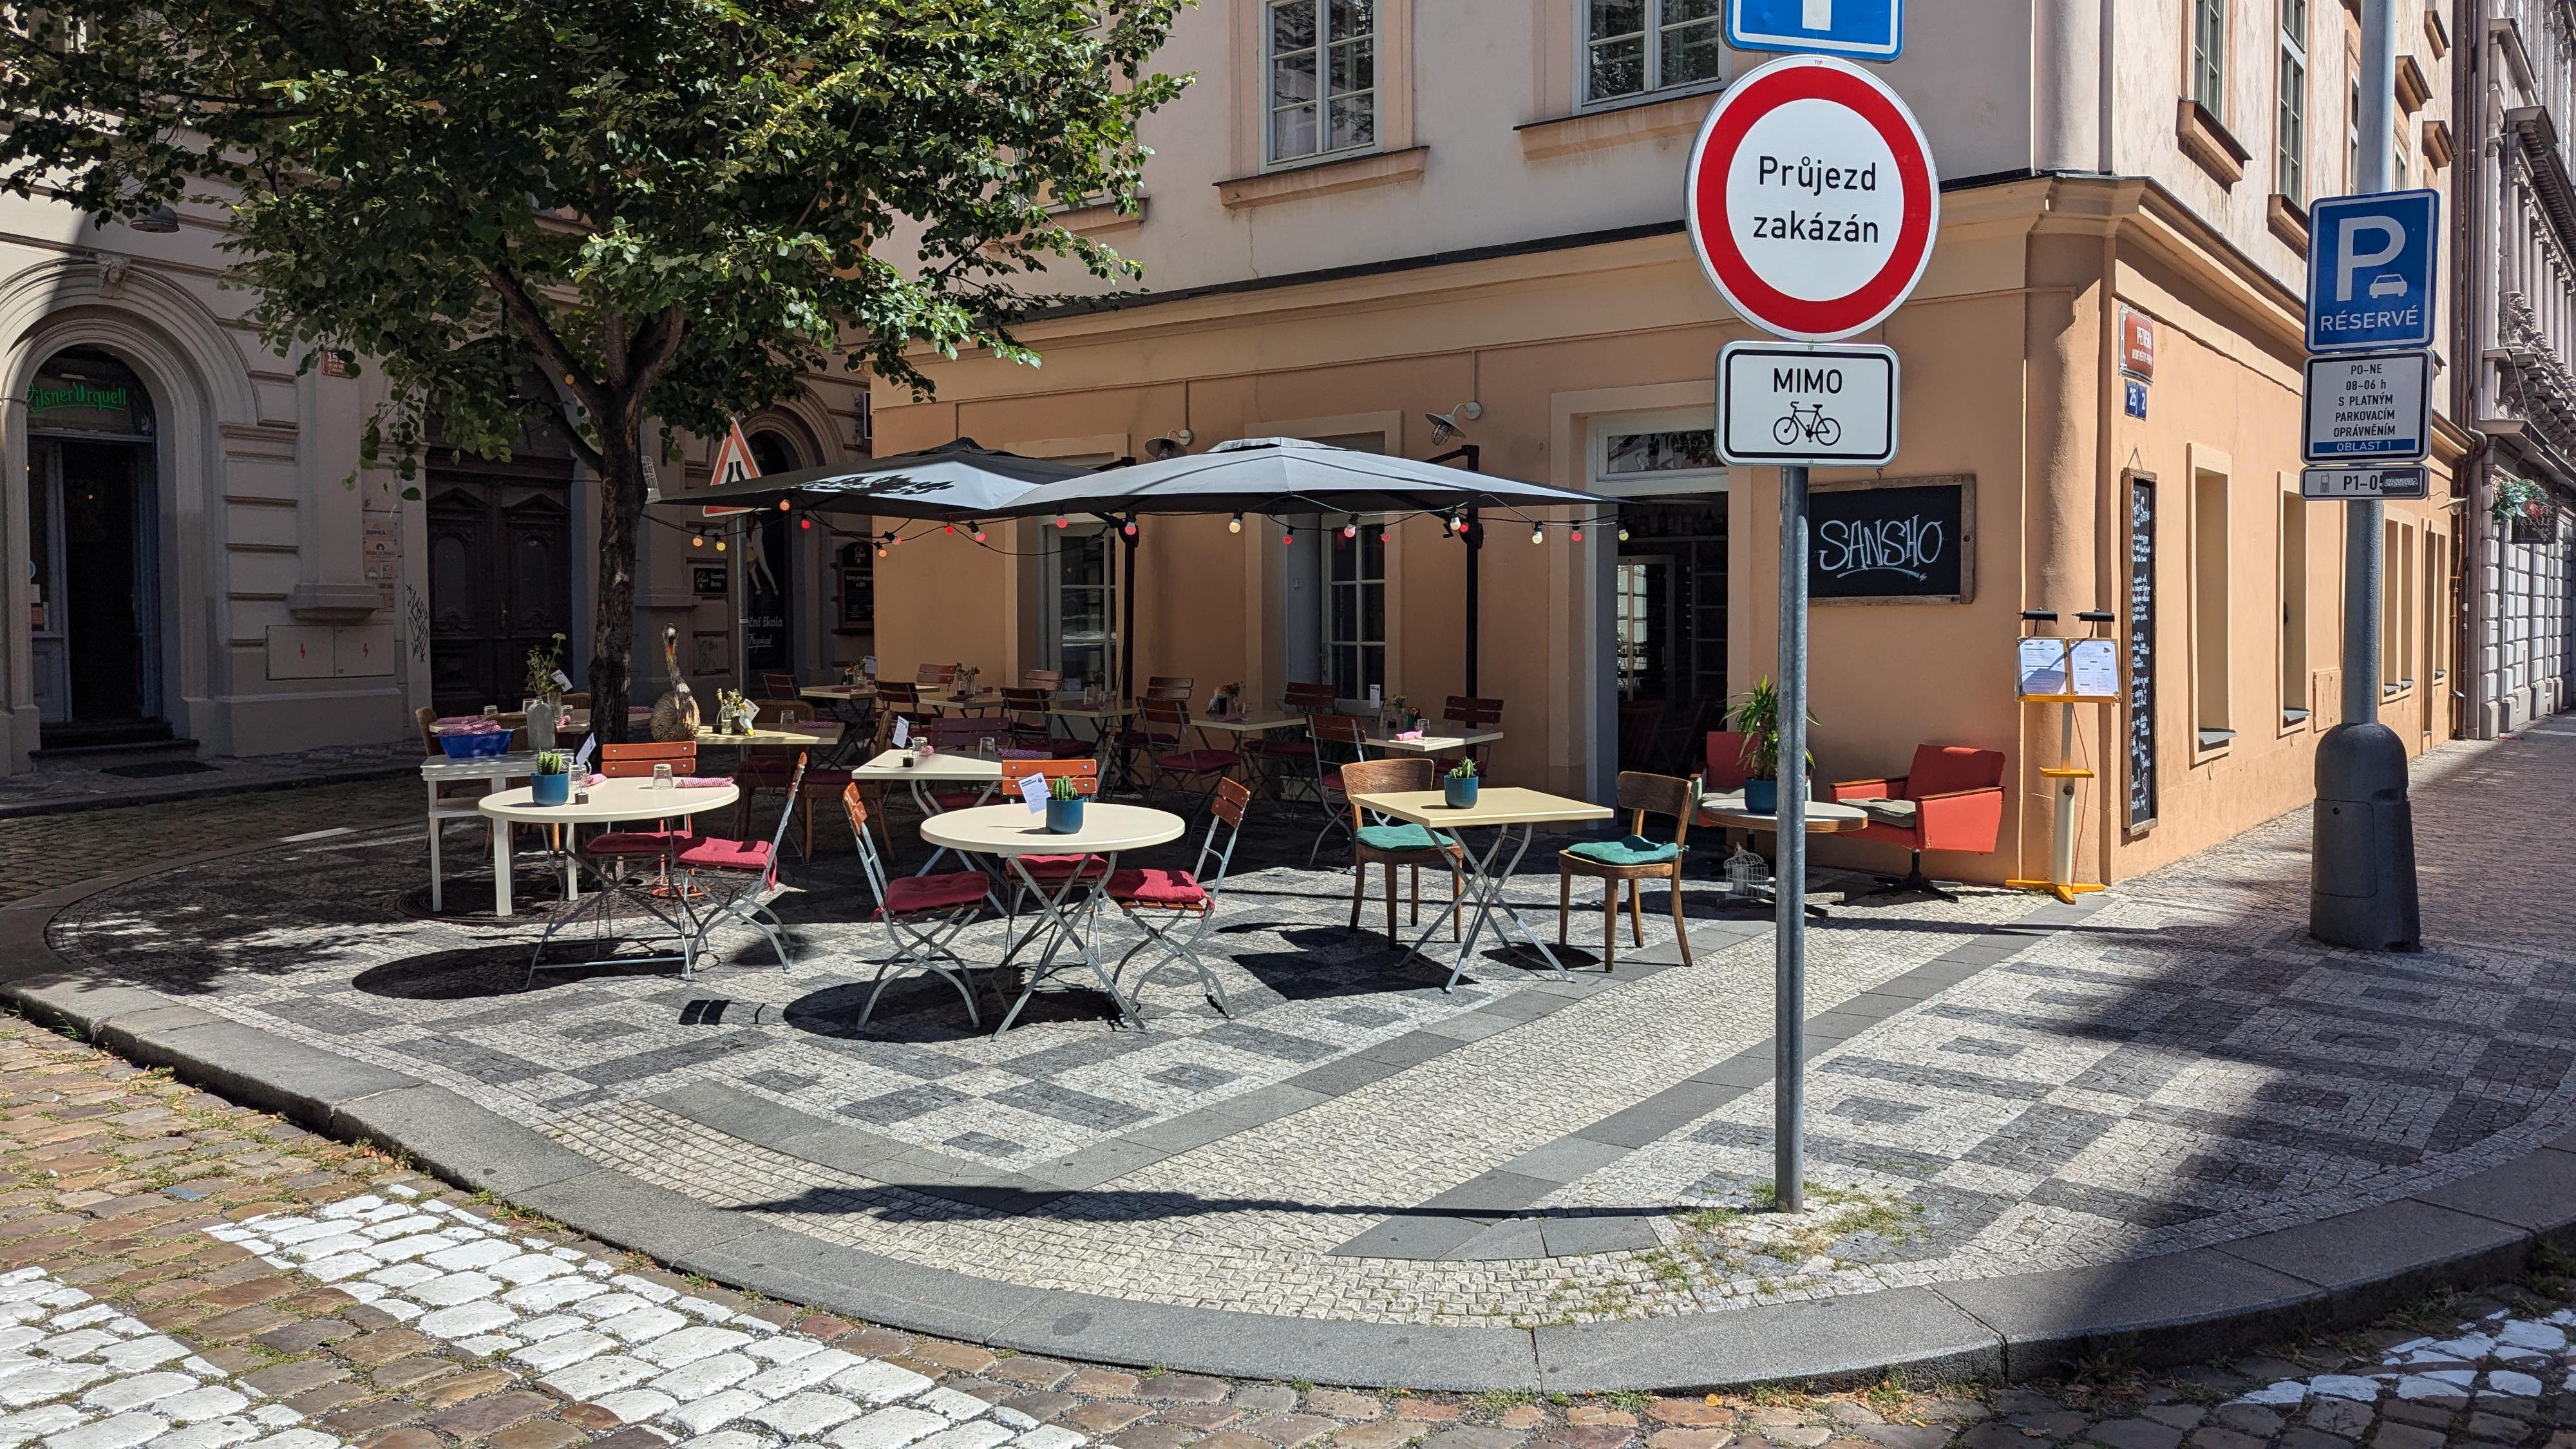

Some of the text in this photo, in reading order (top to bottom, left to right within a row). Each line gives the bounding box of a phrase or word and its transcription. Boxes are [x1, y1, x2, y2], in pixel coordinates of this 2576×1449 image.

[1759, 155, 1876, 196] Průjezd
[1753, 210, 1879, 243] zakázán
[2336, 215, 2406, 301] P
[2320, 305, 2418, 331] RÉSERVÉ
[1773, 367, 1842, 394] MIMO
[2351, 363, 2383, 375] PO-NE
[73, 381, 127, 411] Urquell
[2345, 379, 2387, 390] 08-06 h
[2129, 387, 2146, 411] 25 2
[2338, 392, 2393, 406] S PLATNÝM
[2335, 408, 2395, 422] PARKOVACÍM
[2333, 423, 2396, 437] OPRÁVNĚNÍM
[2336, 440, 2391, 451] OBLAST 1
[1818, 515, 1943, 571] SANSHO
[762, 616, 783, 627] škola
